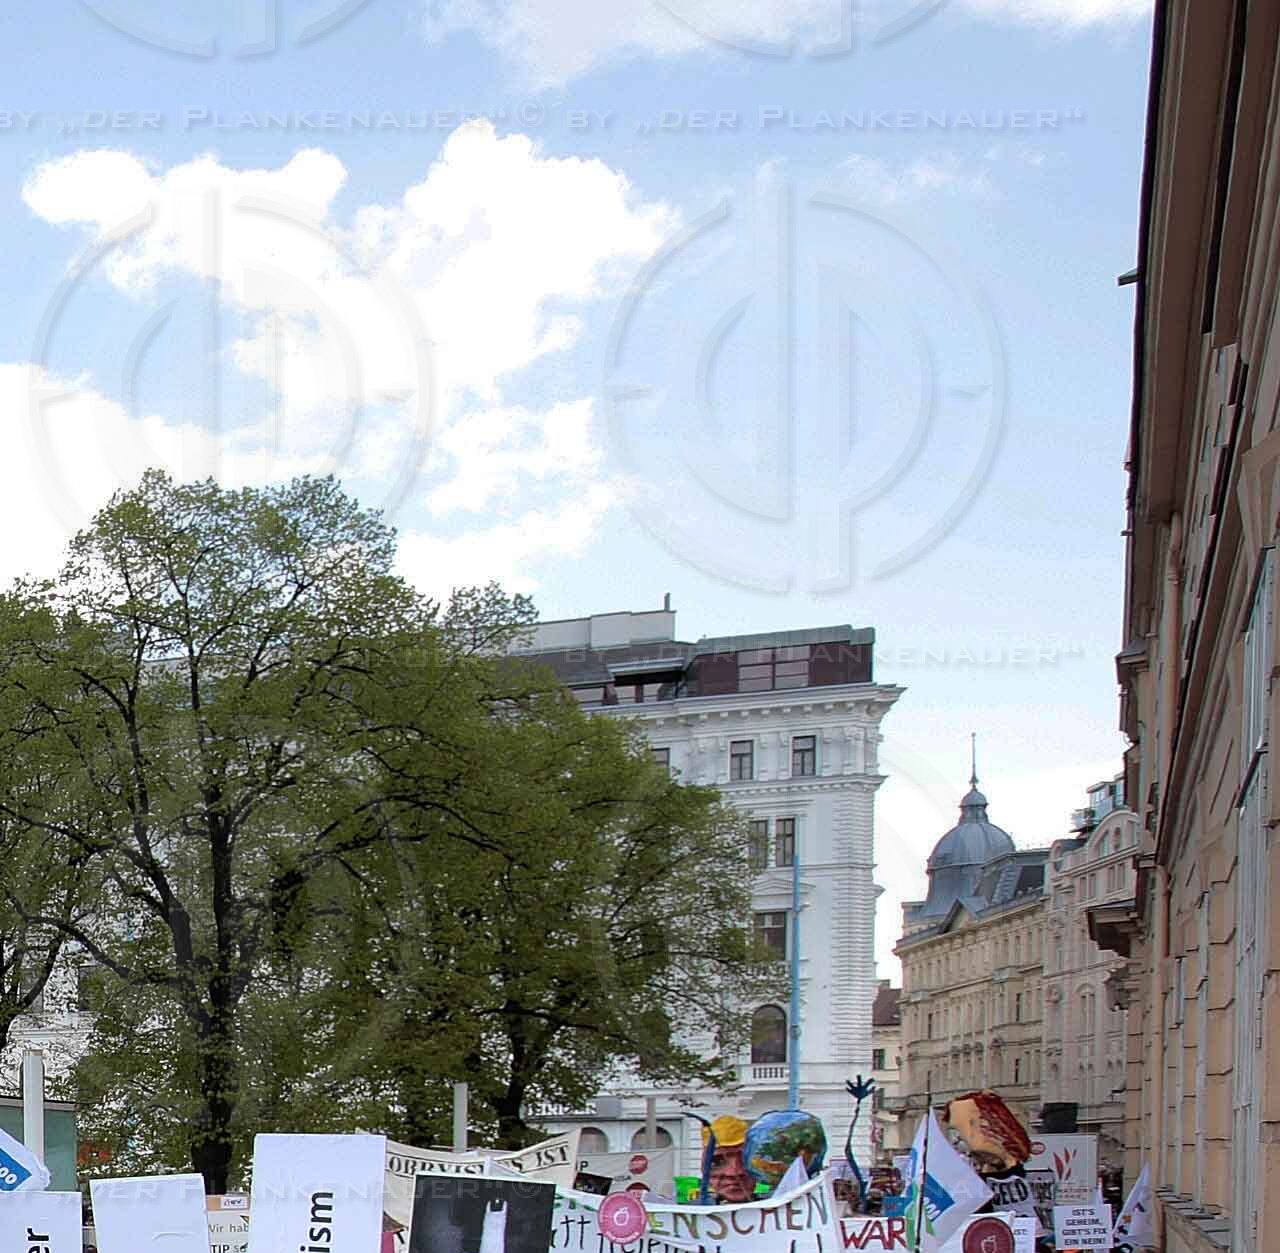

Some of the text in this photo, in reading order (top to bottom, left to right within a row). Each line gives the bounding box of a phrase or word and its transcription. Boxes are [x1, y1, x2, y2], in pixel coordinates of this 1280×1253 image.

[535, 1144, 570, 1171] IST
[646, 1186, 829, 1240] ENSCHEN
[1064, 1238, 1079, 1246] EIN
